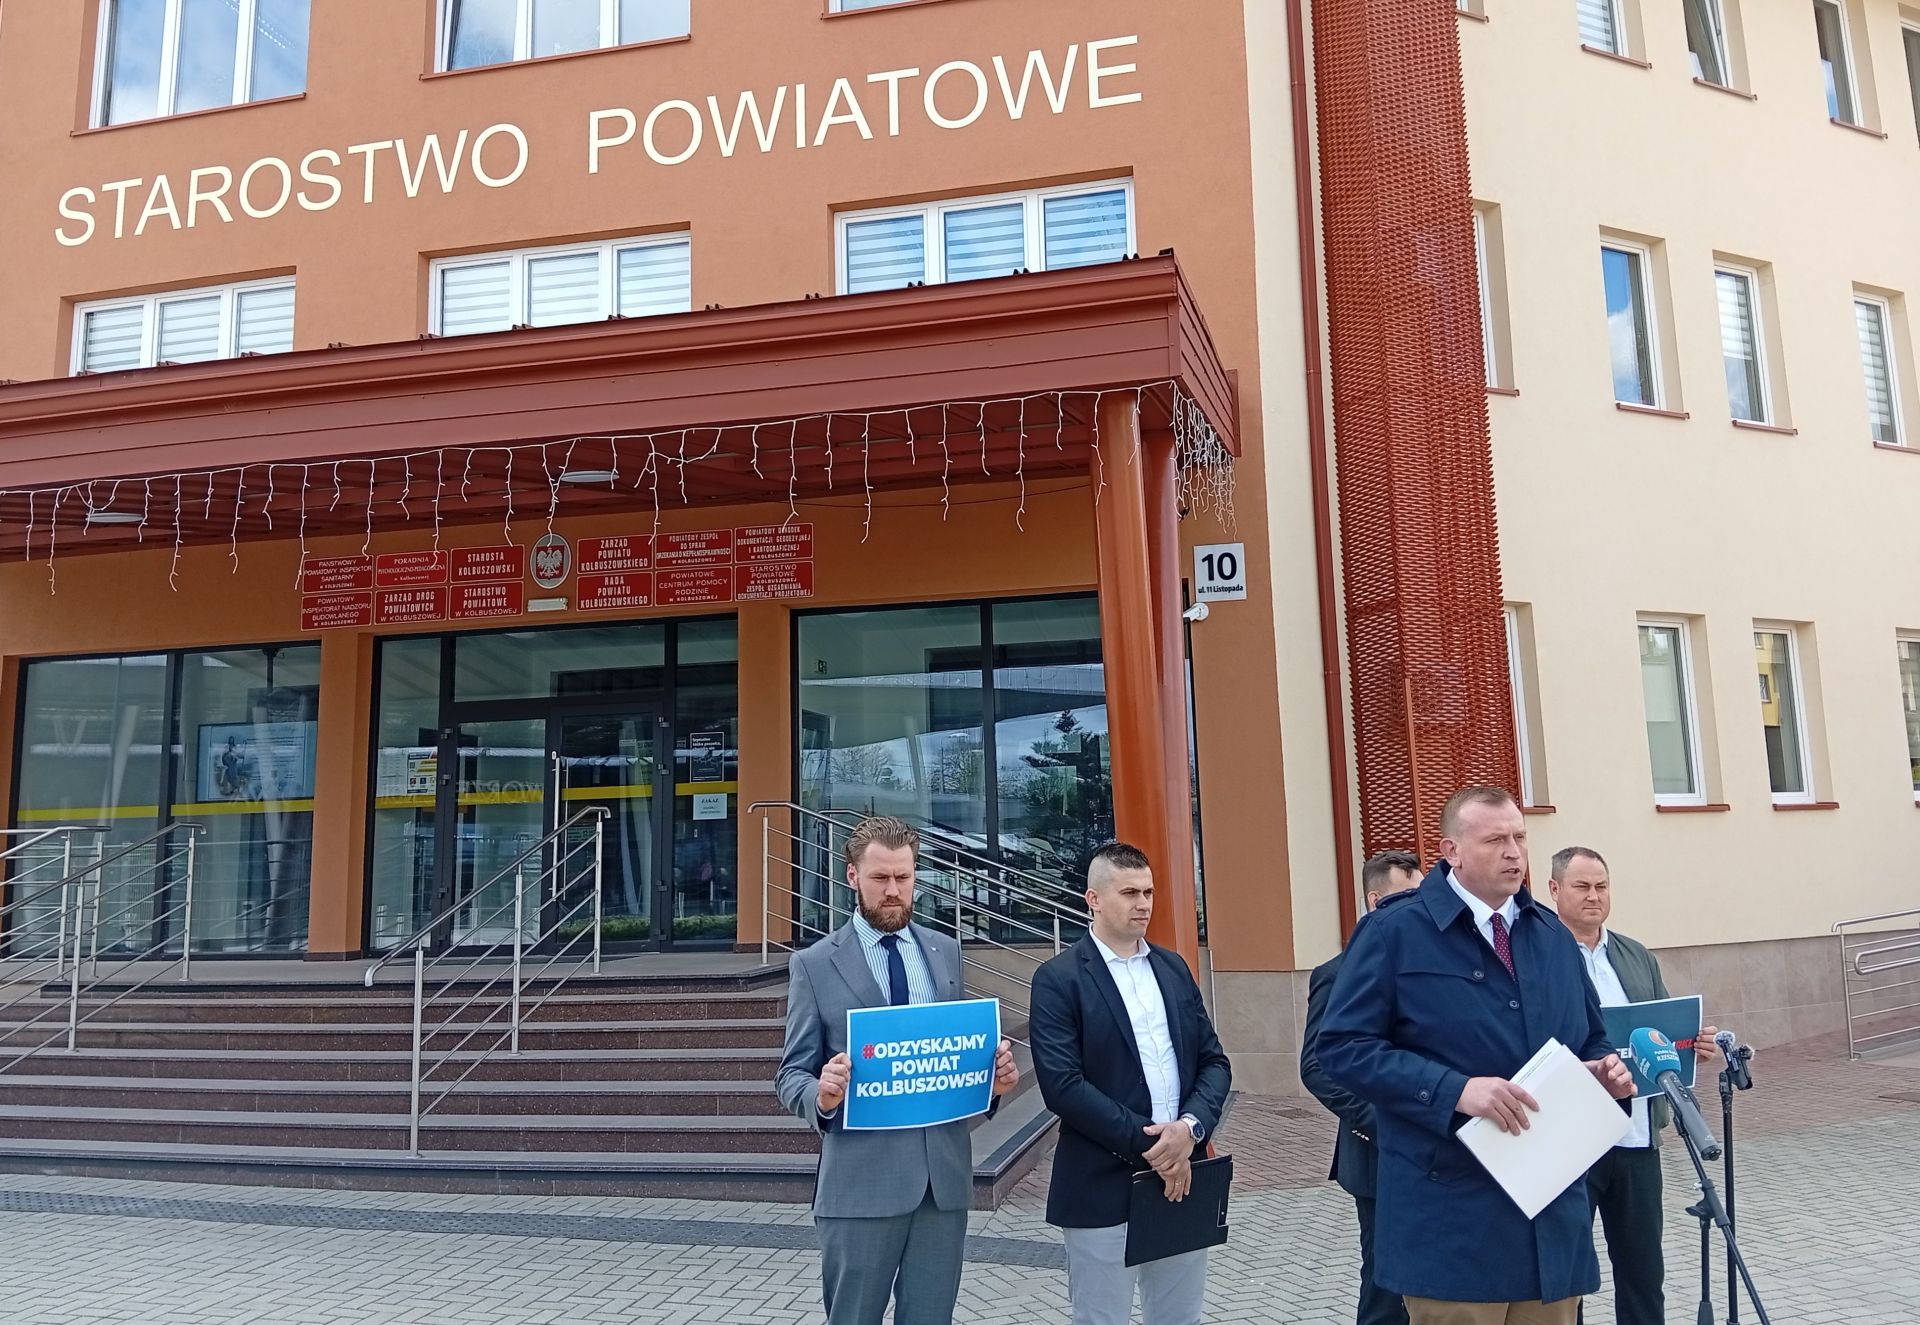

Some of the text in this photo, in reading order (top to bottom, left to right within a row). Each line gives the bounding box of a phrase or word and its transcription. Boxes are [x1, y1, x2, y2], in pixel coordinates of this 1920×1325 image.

[54, 35, 1142, 247] STAROSTWO POWIATOWE
[746, 528, 775, 536] POWIATOWY
[669, 534, 698, 542] POWIATOWY
[737, 534, 810, 545] DOKUMENTACJI GEODEZYJNEJ
[600, 538, 628, 549] ZARZĄD
[753, 544, 800, 553] KARTOGRAFICZNEJ
[468, 552, 504, 562] STAROSTA
[598, 548, 631, 559] POWIATU
[394, 556, 429, 565] PORADNIA
[581, 558, 648, 572] KOLBUSZOWSKIEGO
[458, 564, 515, 576] KOLBUSZOWSKI
[750, 564, 797, 573] STAROSTWO
[1202, 552, 1237, 581] 10
[321, 574, 354, 582] SANITARNY
[671, 571, 715, 579] POWIATOWE
[752, 570, 795, 578] POWIATOWE
[604, 576, 624, 586] RADA
[659, 578, 728, 589] CENTRUM POMOCY
[464, 586, 506, 597] STAROSTWO
[598, 586, 631, 596] POWIATU
[768, 583, 801, 591] UZGADNIANIA
[1198, 586, 1206, 594] ul.
[1214, 584, 1243, 594] Listopada
[384, 591, 435, 603] ZARZĄD DRÓG
[738, 589, 810, 600] DOKUMENTACJI PROJEKTOWEJ
[318, 596, 354, 604] POWIATOWY
[463, 598, 507, 609] POWIATOWE
[580, 595, 648, 608] KOLBUSZOWSKIEGO
[342, 602, 371, 611] NADZORU
[384, 602, 434, 614] POWIATOWYCH
[312, 611, 359, 621] BUDOWLANEGO
[389, 613, 441, 621] KOLBUSZOWEJ
[465, 608, 518, 617] KOLBUSZOWEJ
[862, 1033, 987, 1060] #ODZYSKAJMY
[891, 1055, 960, 1076] POWIAT
[856, 1069, 989, 1098] KOLBUSZOWSKI
